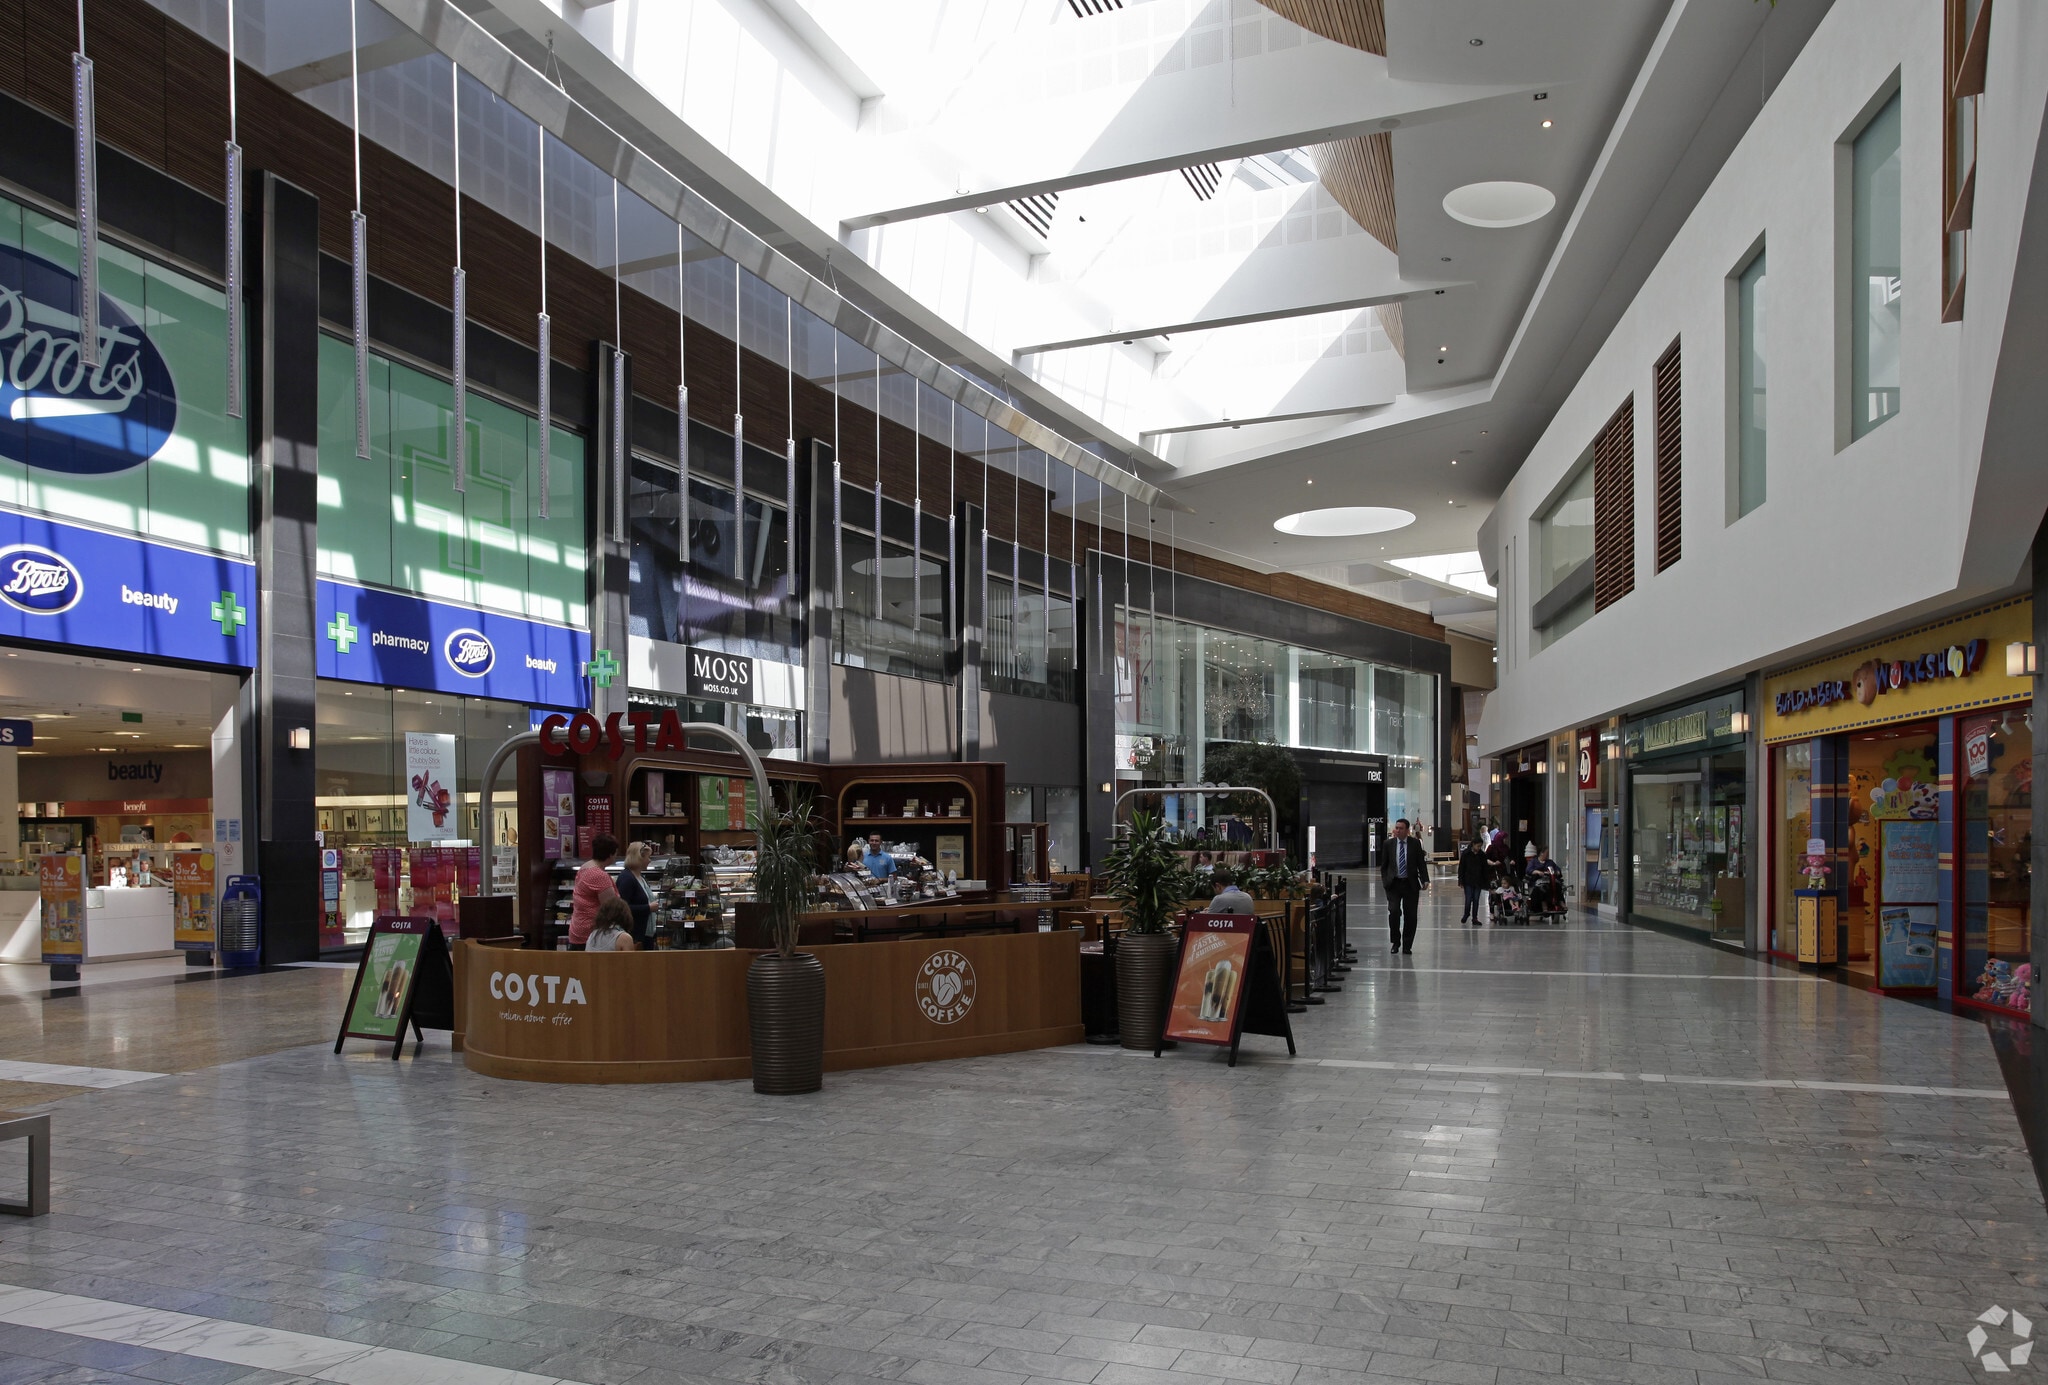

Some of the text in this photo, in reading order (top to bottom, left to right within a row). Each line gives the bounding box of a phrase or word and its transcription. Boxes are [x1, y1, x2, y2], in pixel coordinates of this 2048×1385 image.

[4, 558, 69, 597] Boots
[122, 584, 178, 614] beauty
[372, 630, 429, 654] pharmacy
[455, 638, 489, 665] Boots
[526, 654, 557, 674] beauty
[693, 654, 748, 685] MOSS
[1875, 639, 1986, 694] WORKSHOP
[703, 683, 739, 696] MOSS.CO.UK
[408, 737, 424, 746] Have
[539, 708, 688, 761] COSTA
[409, 757, 428, 765] Chubby
[1968, 741, 1986, 761] 100
[108, 760, 162, 783] beauty
[1367, 770, 1383, 782] next
[123, 801, 147, 812] benefit
[588, 797, 609, 805] COSTA
[42, 867, 49, 880] 3
[57, 867, 64, 880] 2
[176, 862, 182, 875] 3
[190, 862, 198, 875] 2
[391, 921, 412, 930] COSTA
[1208, 919, 1234, 929] COSTA
[1192, 935, 1219, 952] TASTE
[1195, 939, 1227, 959] summer
[924, 953, 966, 975] COSTA
[490, 971, 587, 1007] COSTA
[921, 994, 971, 1021] COFFEE
